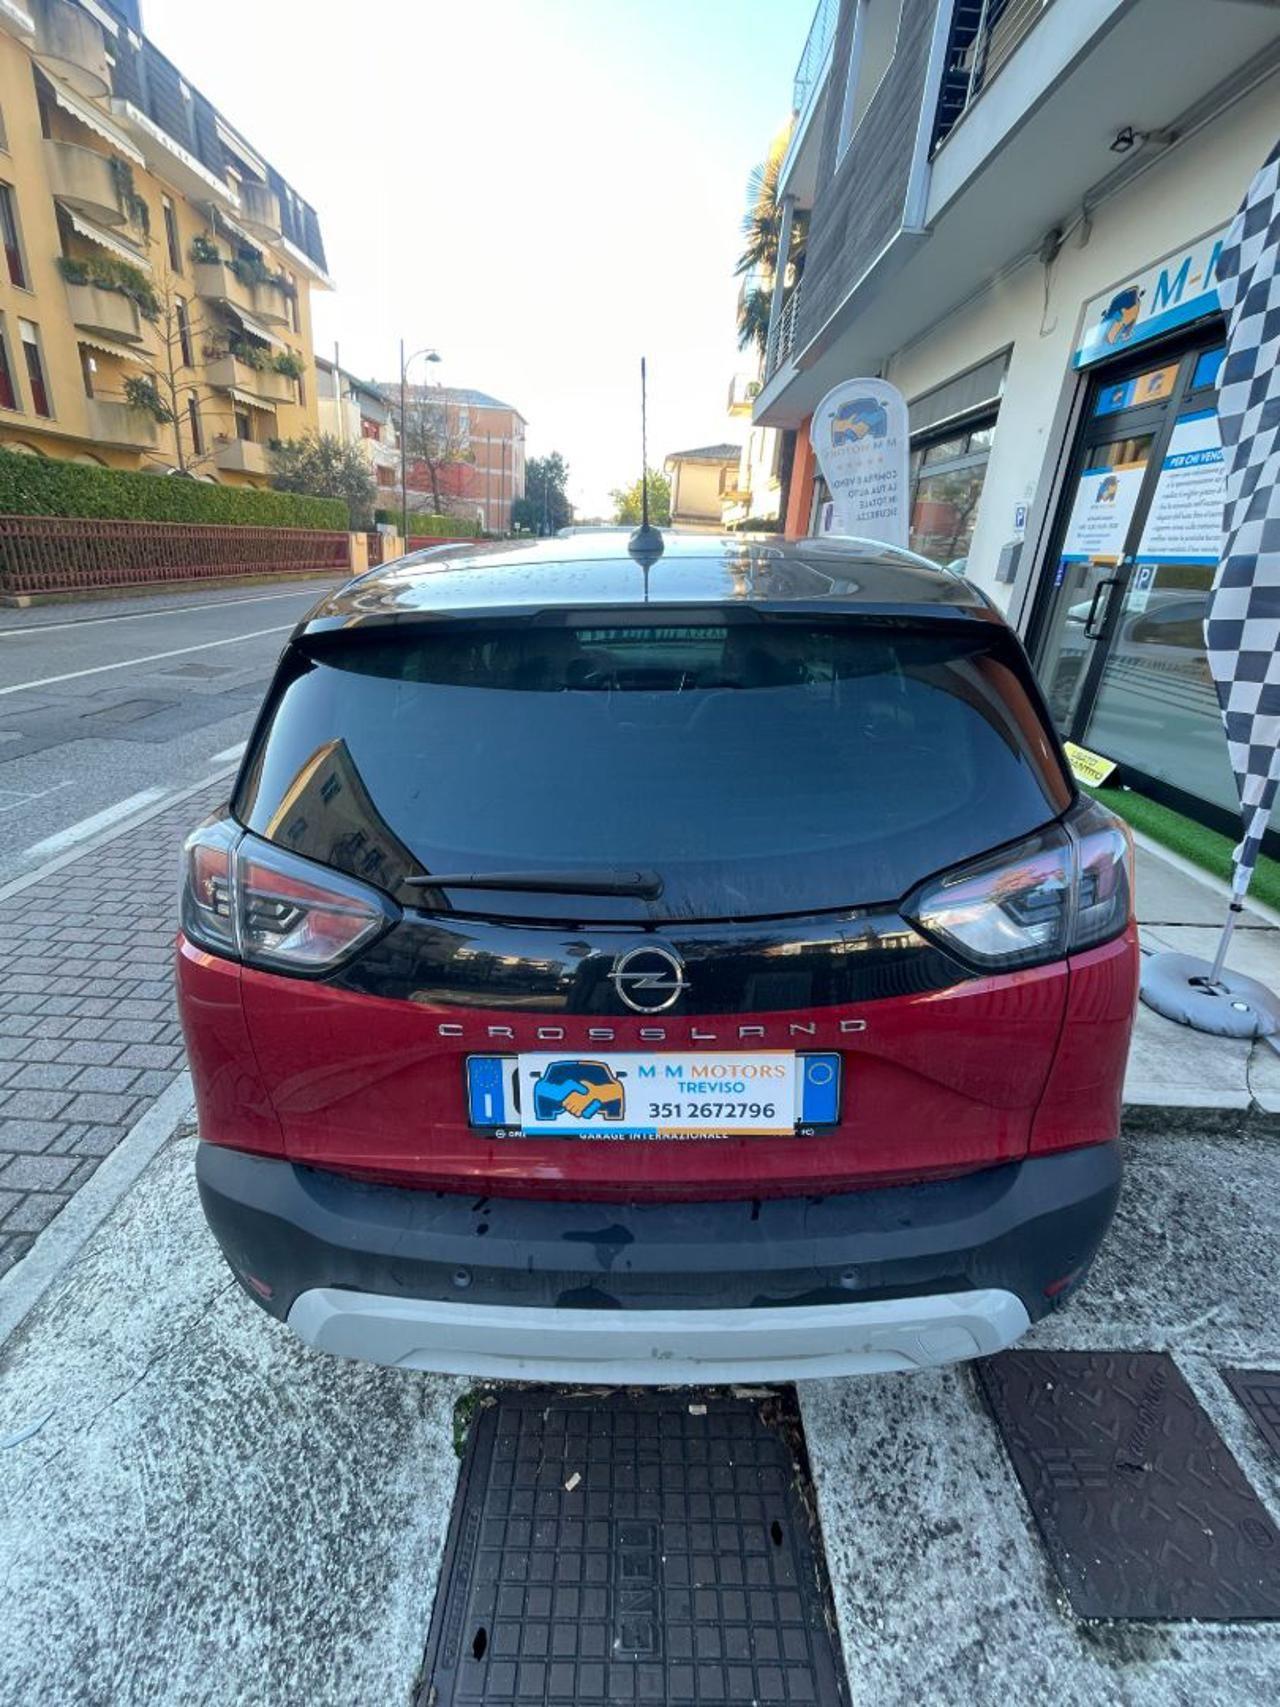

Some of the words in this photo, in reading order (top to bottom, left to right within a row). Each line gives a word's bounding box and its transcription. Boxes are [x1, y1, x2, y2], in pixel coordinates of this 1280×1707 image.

[438, 1019, 867, 1042] CROSSLAND
[638, 1065, 656, 1078] M
[665, 1065, 683, 1078] M
[691, 1065, 785, 1078] MOTORS
[677, 1082, 746, 1094] TREVISO
[649, 1103, 682, 1118] 351
[687, 1103, 776, 1119] 2672796
[579, 1132, 625, 1140] GARAGE
[629, 1131, 729, 1140] INTERNAZIONALE
